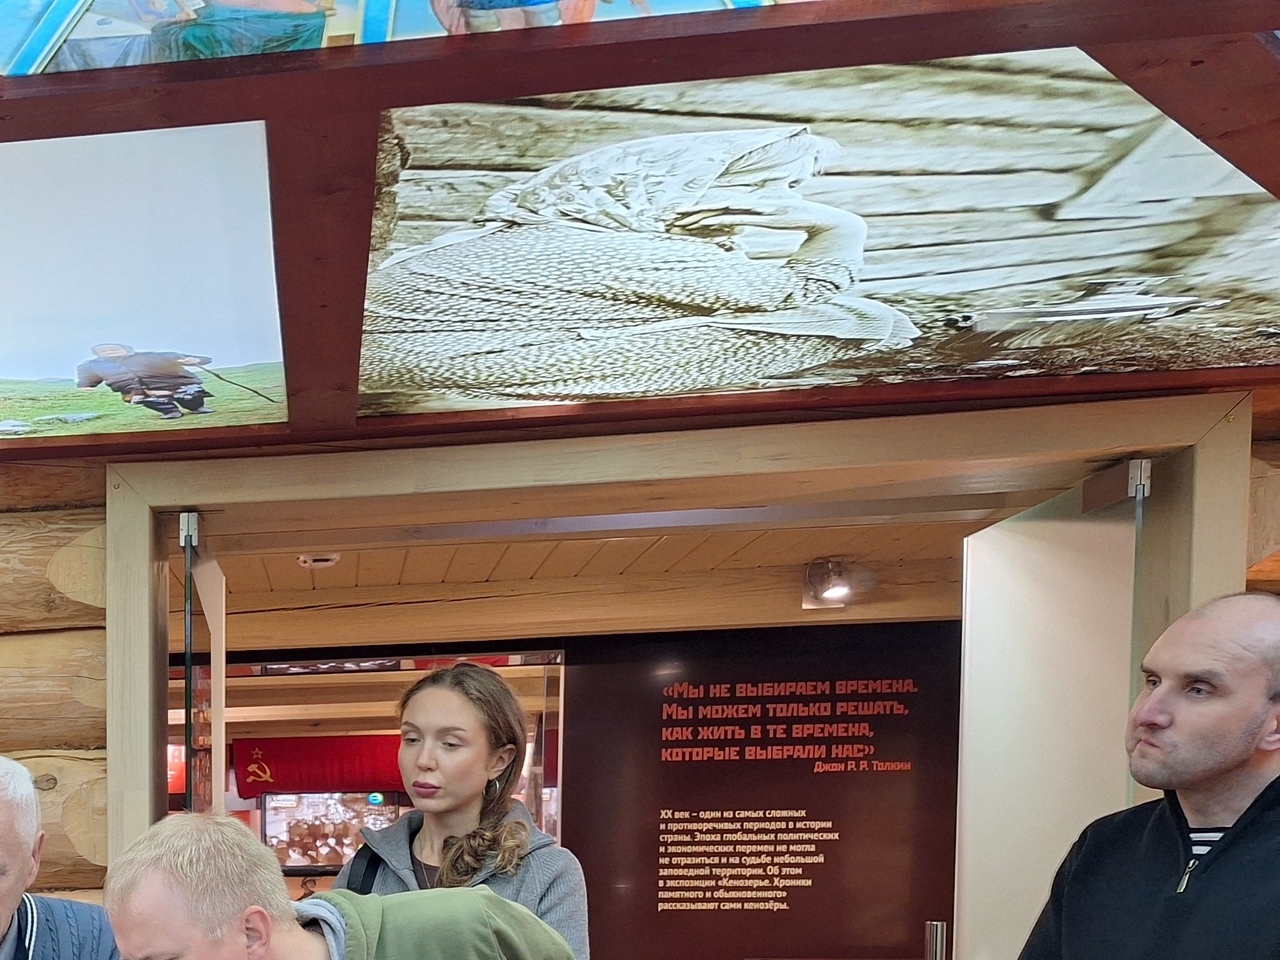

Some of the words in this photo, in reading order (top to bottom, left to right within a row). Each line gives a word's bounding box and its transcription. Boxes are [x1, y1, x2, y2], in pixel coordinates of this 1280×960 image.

[735, 681, 830, 697] ВЫБИРАЕМ
[698, 704, 761, 719] МОЖЕМ
[766, 702, 831, 717] ТОЛЬКО
[661, 727, 693, 740] КАК
[697, 726, 745, 740] ЖИТЬ
[750, 725, 762, 738] В
[766, 724, 787, 738] ТЕ
[661, 746, 740, 761] КОТОРЫЕ
[745, 745, 826, 760] ВЫБРАЛИ
[813, 761, 845, 773] Джон
[871, 761, 911, 771] Толкин
[674, 811, 690, 819] век
[699, 810, 721, 819] один
[723, 810, 733, 818] из
[735, 809, 764, 818] самых
[766, 809, 806, 818] сложных
[667, 822, 741, 832] противоречивых
[743, 821, 786, 831] периодов
[795, 821, 832, 831] истории
[694, 832, 721, 841] Эпоха
[723, 831, 775, 841] глобальных
[777, 832, 840, 840] политических
[666, 845, 734, 853] экономических
[736, 844, 774, 854] перемен
[776, 844, 787, 852] не
[789, 844, 816, 852] могла
[671, 856, 719, 866] отразиться
[729, 856, 740, 864] на
[741, 854, 772, 866] судьбе
[773, 853, 824, 864] небольшой
[658, 866, 710, 877] заповедной
[711, 867, 765, 877] территории.
[766, 865, 779, 875] Об
[781, 867, 802, 875] этом
[665, 879, 716, 888] экспозиции
[773, 877, 812, 888] Хроники
[657, 902, 719, 912] рассказывают
[720, 902, 742, 910] сами
[743, 900, 790, 912] кенозёры.
